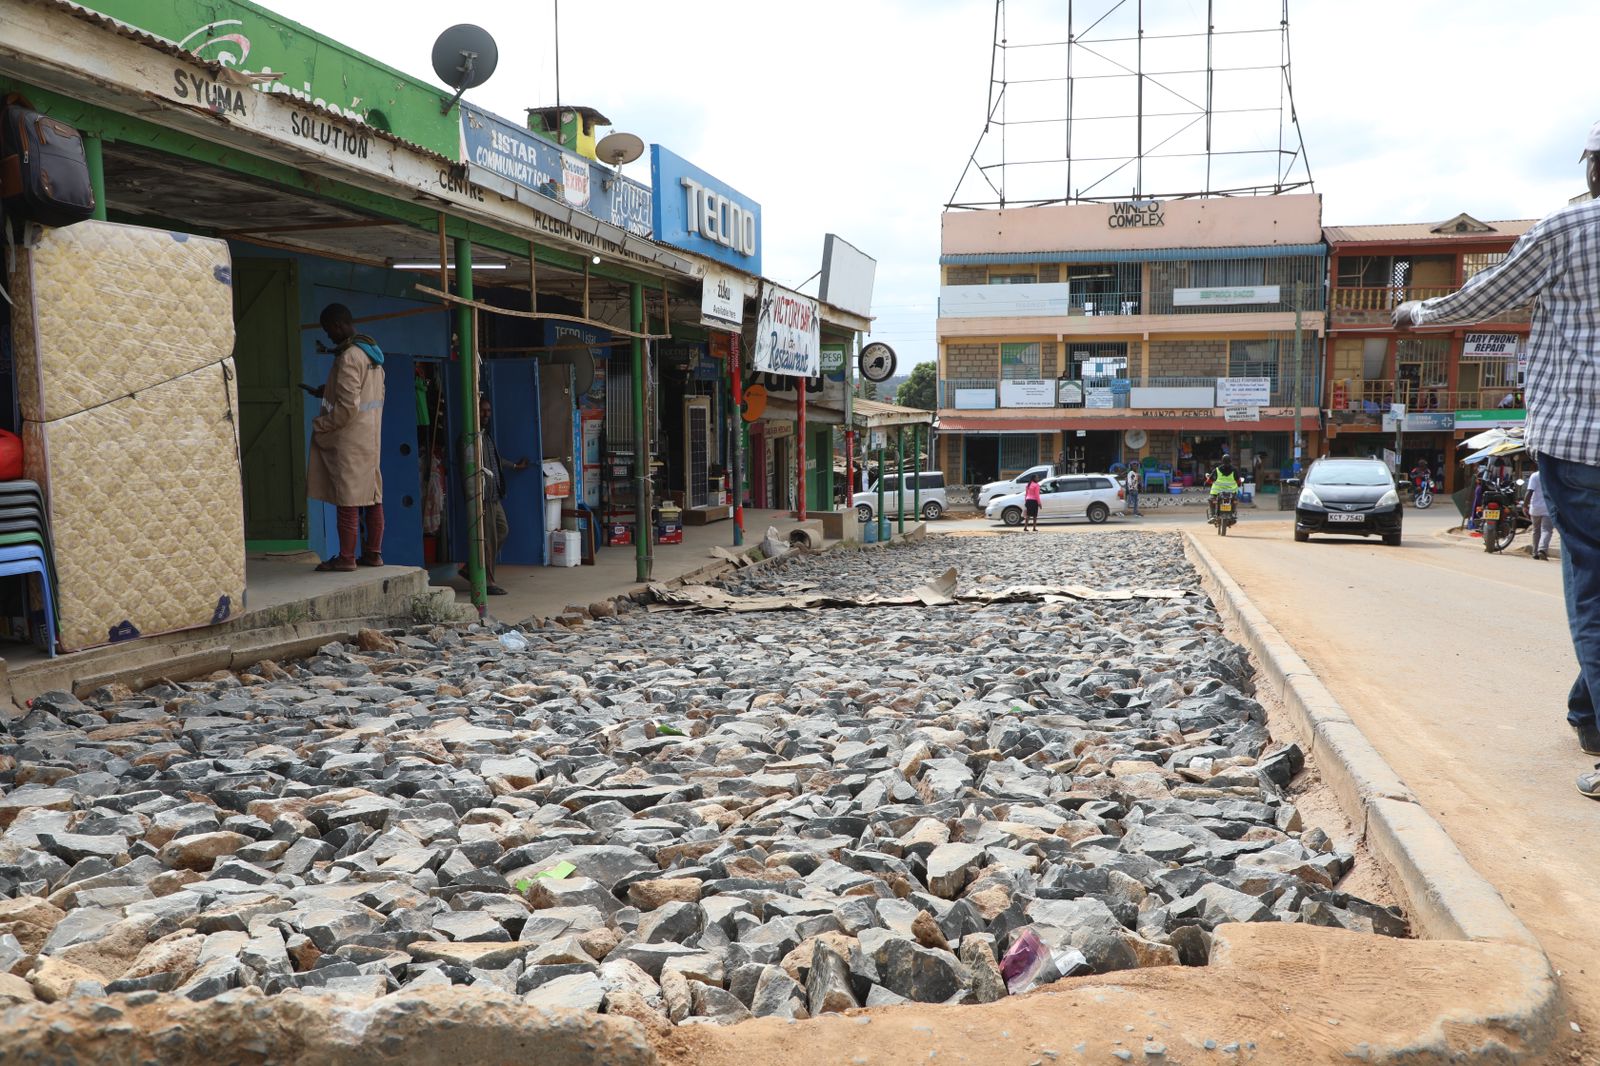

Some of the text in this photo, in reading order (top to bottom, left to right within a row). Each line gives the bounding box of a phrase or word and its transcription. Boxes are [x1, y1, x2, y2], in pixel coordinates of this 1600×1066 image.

[174, 68, 246, 117] SYUMA
[291, 111, 368, 159] SOLUTION
[680, 176, 755, 257] TECNO
[1108, 212, 1165, 228] COMPLEX
[773, 296, 800, 331] VICTORY
[768, 331, 809, 374] Restaurant
[1465, 334, 1517, 344] LARY PHONE
[1474, 343, 1506, 352] REPAIR
